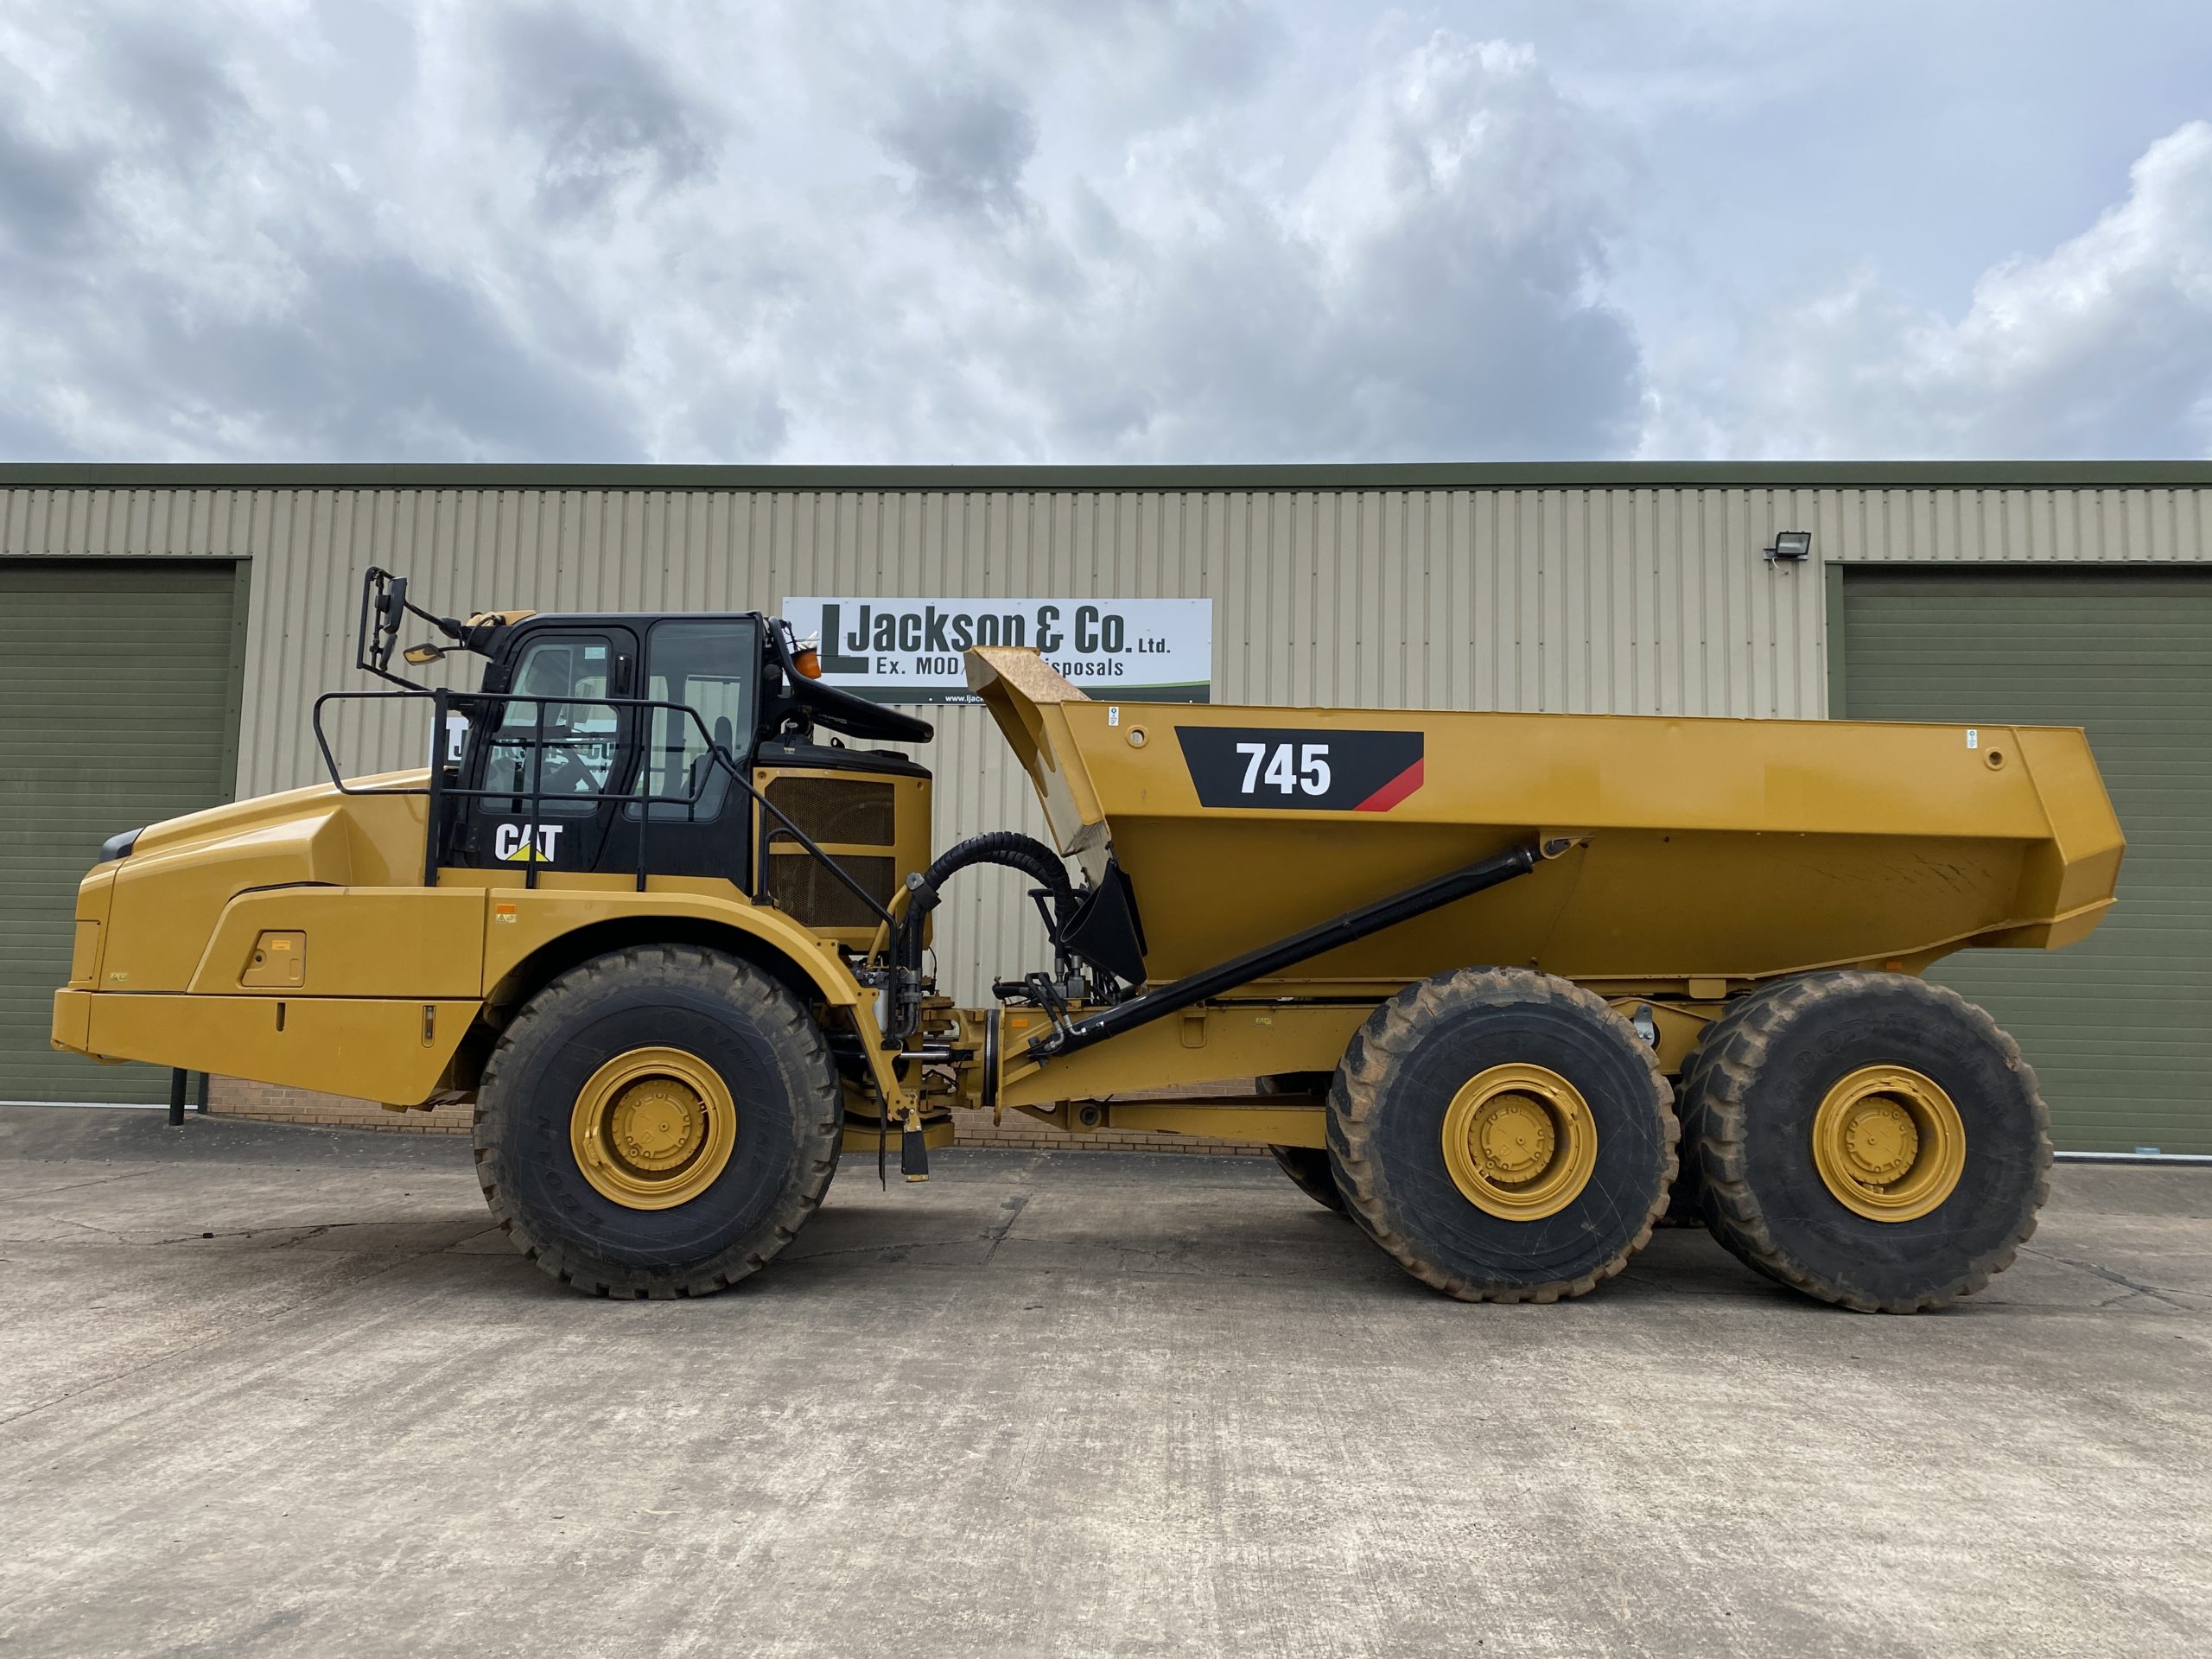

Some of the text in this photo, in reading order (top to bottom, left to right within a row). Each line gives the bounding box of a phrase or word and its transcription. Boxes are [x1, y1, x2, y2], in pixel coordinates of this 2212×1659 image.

[1036, 605, 1064, 653] &
[1074, 605, 1133, 653] Co.
[1138, 638, 1171, 653] Ltd.
[876, 657, 906, 675] Ex.
[1045, 658, 1123, 679] sposals
[1236, 742, 1331, 796] 745
[494, 823, 563, 862] CAT
